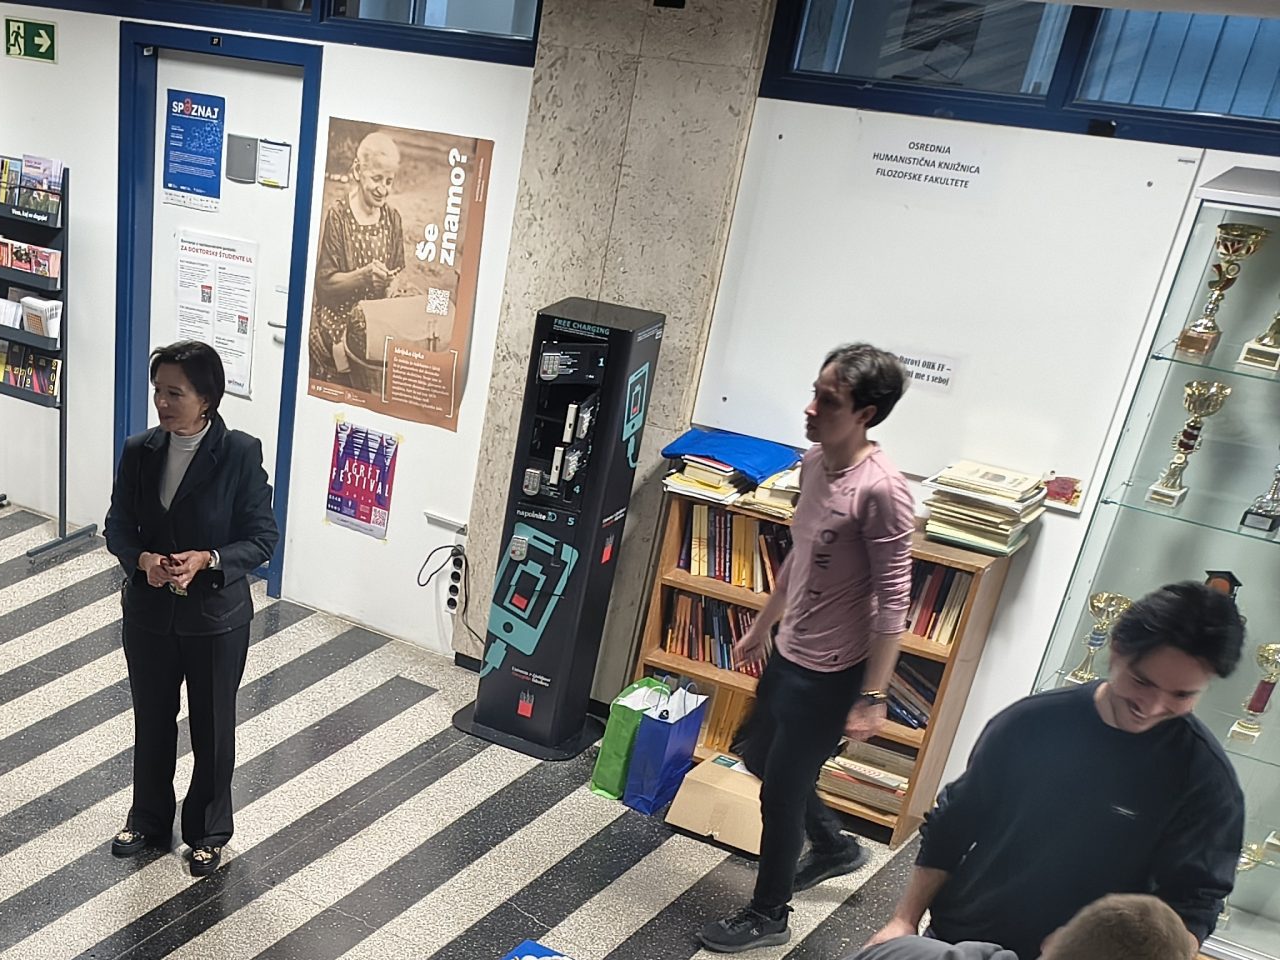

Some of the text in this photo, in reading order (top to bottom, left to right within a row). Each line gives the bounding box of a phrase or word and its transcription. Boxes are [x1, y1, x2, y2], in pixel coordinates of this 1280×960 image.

[172, 98, 220, 119] SPOZNAJ
[908, 141, 951, 155] OSREDNJA
[872, 152, 980, 175] HUMANISTIČNA KNJIŽNICA
[875, 167, 970, 189] FILOZOFSKE FAKULTETE
[439, 147, 468, 267] znamo?
[415, 223, 439, 263] Še
[553, 318, 571, 328] FREE
[572, 320, 610, 336] CHARGING
[598, 357, 605, 367] 1
[332, 467, 390, 497] FESTIVAL
[573, 485, 581, 494] 4
[567, 517, 575, 526] 5
